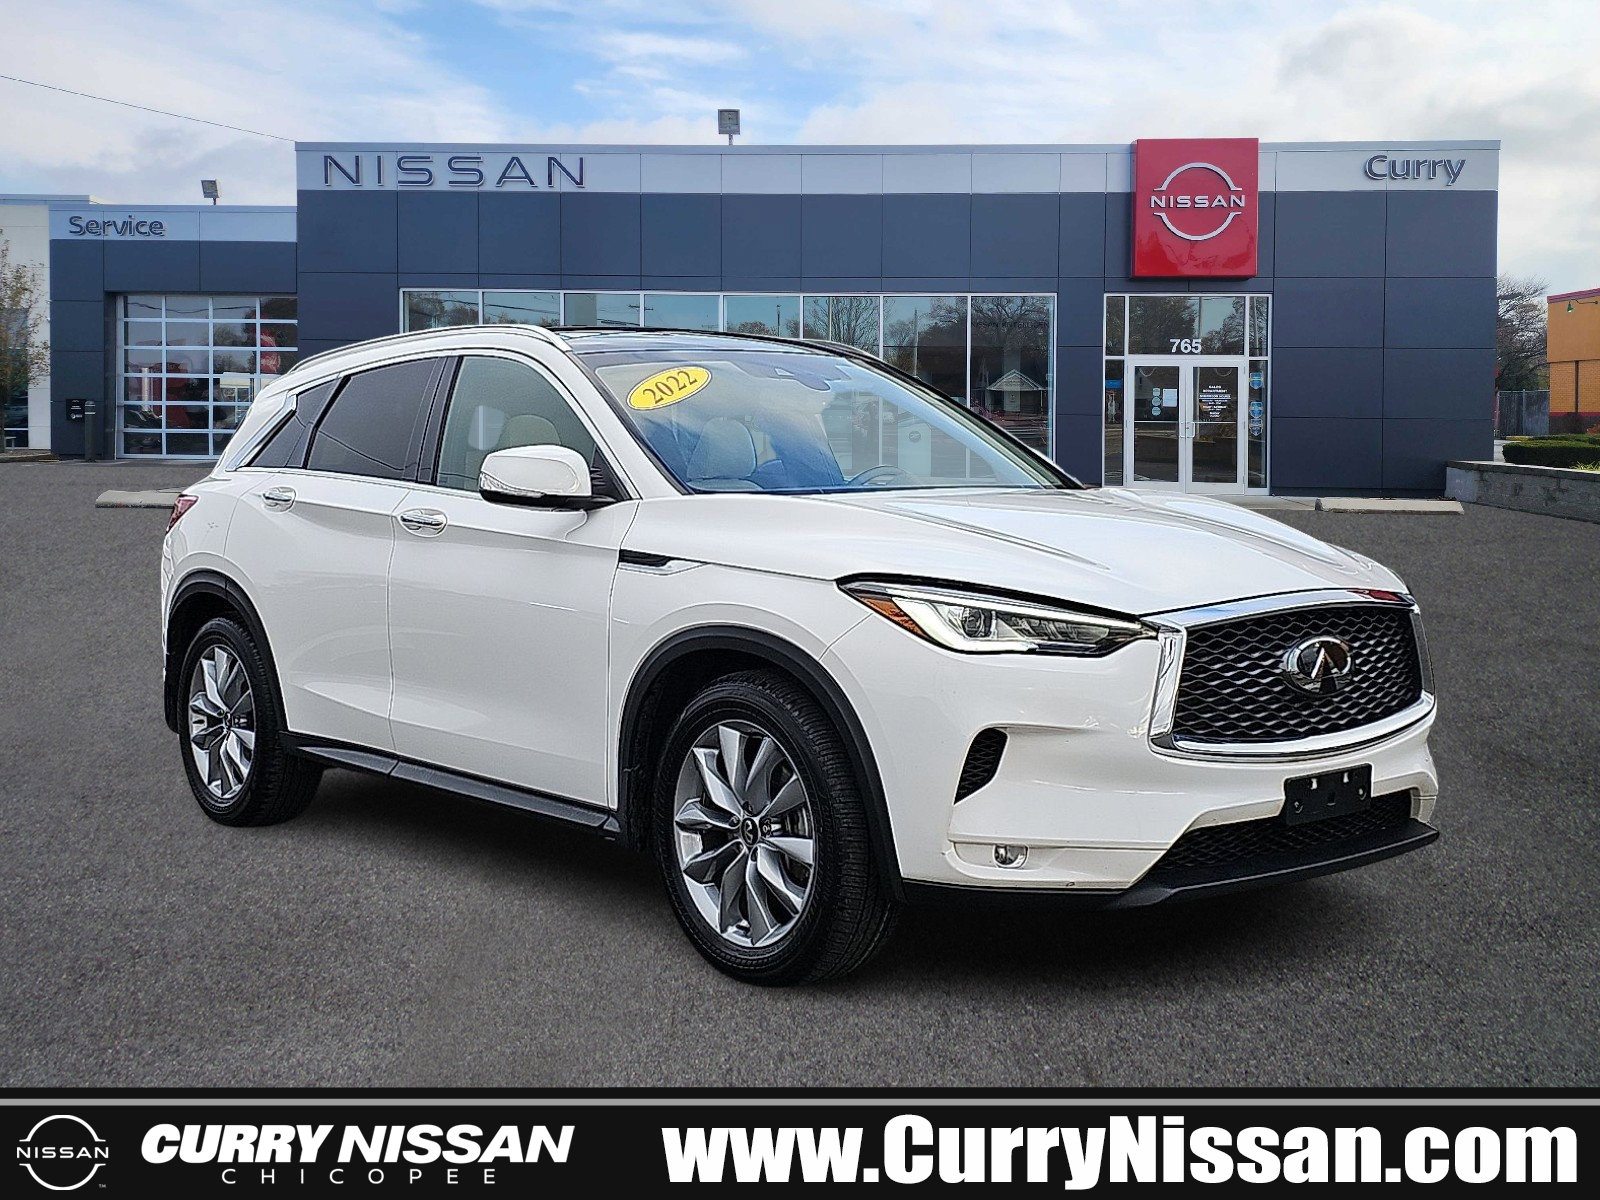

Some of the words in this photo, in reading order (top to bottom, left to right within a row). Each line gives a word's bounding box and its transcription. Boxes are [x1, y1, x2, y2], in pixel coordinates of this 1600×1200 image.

[323, 154, 585, 188] NISSAN
[1364, 154, 1466, 186] Curry
[1150, 194, 1246, 208] NISSAN
[68, 214, 166, 236] Service
[1169, 338, 1202, 354] 765
[642, 370, 698, 405] 2022
